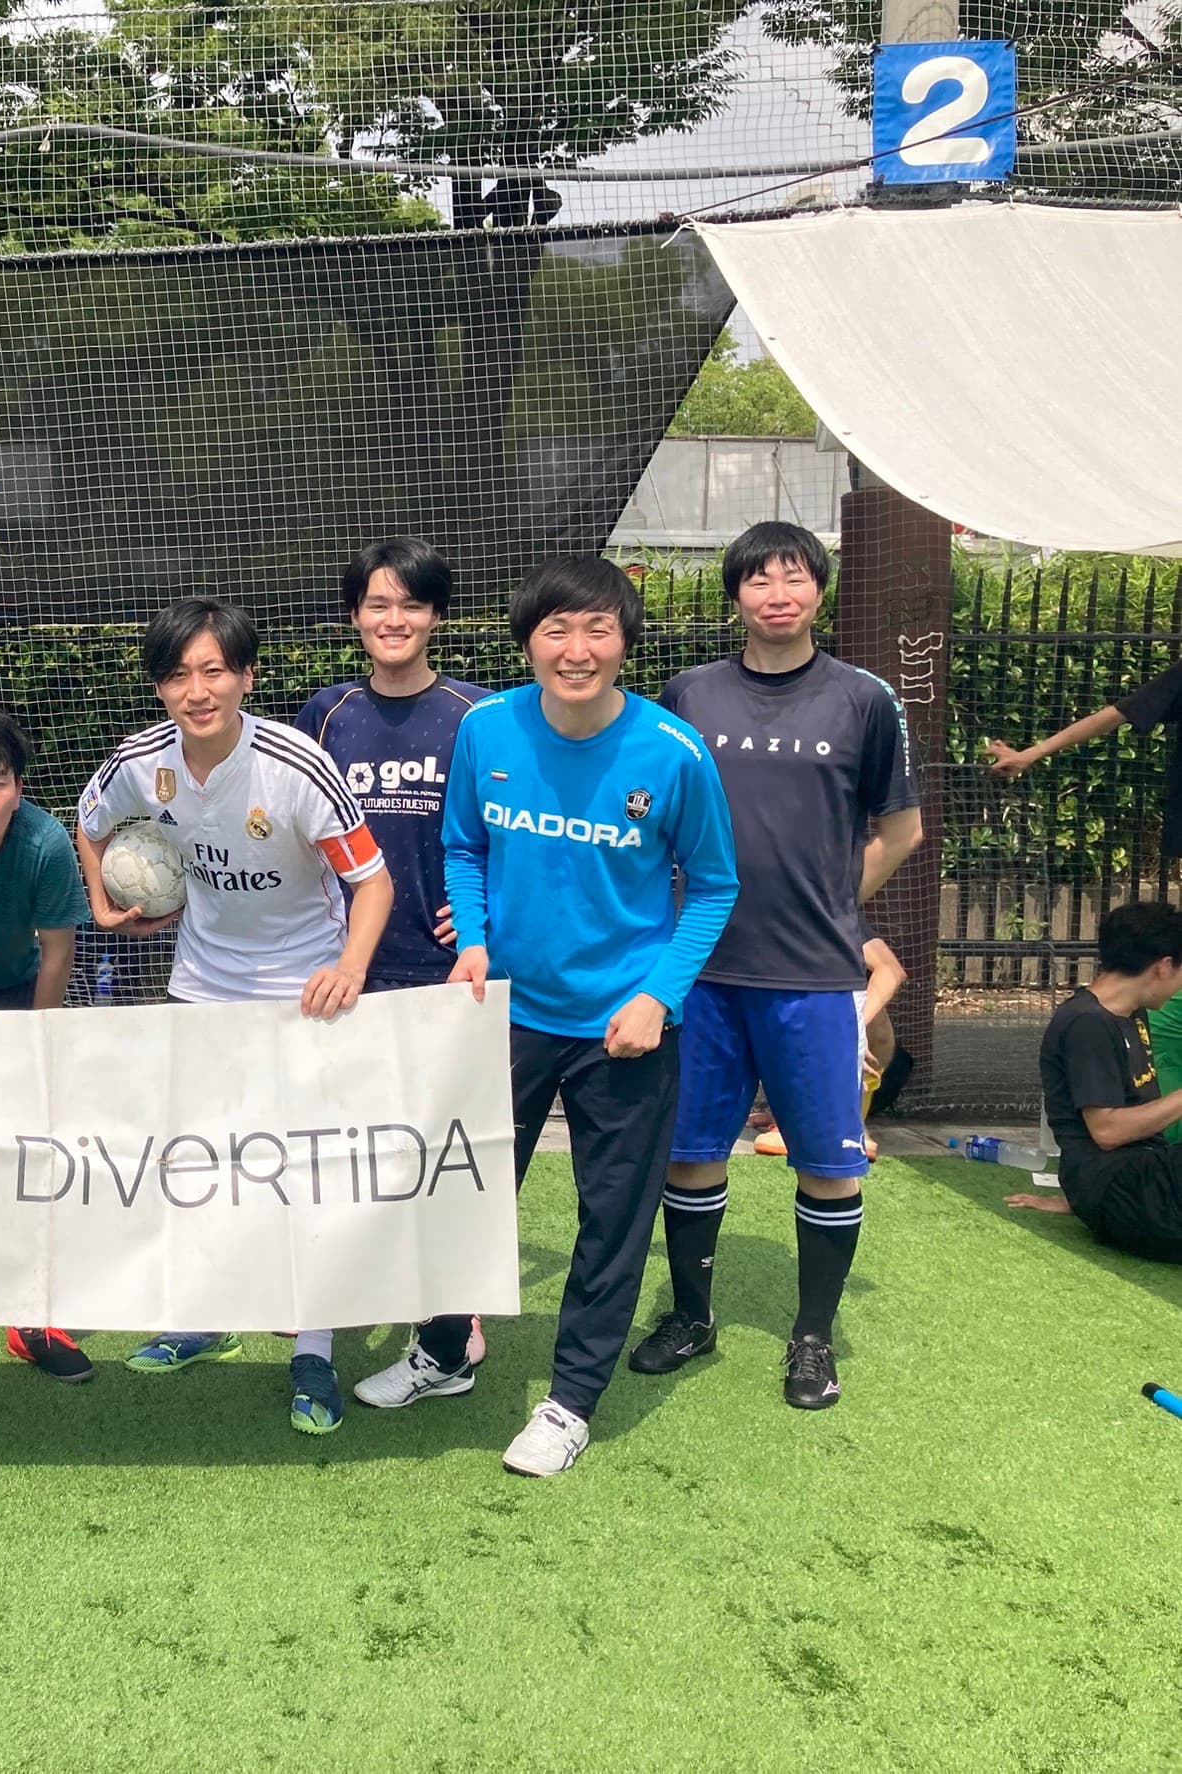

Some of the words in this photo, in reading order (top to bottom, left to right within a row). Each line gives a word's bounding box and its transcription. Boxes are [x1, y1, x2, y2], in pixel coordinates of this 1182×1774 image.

[899, 57, 989, 165] 2
[657, 721, 702, 761] DIADORA
[699, 733, 831, 755] PAZIO
[379, 756, 445, 788] gol.
[391, 799, 401, 809] ES
[402, 799, 440, 811] NUESTRO
[483, 801, 642, 847] DIADORA
[194, 843, 229, 867] Fly
